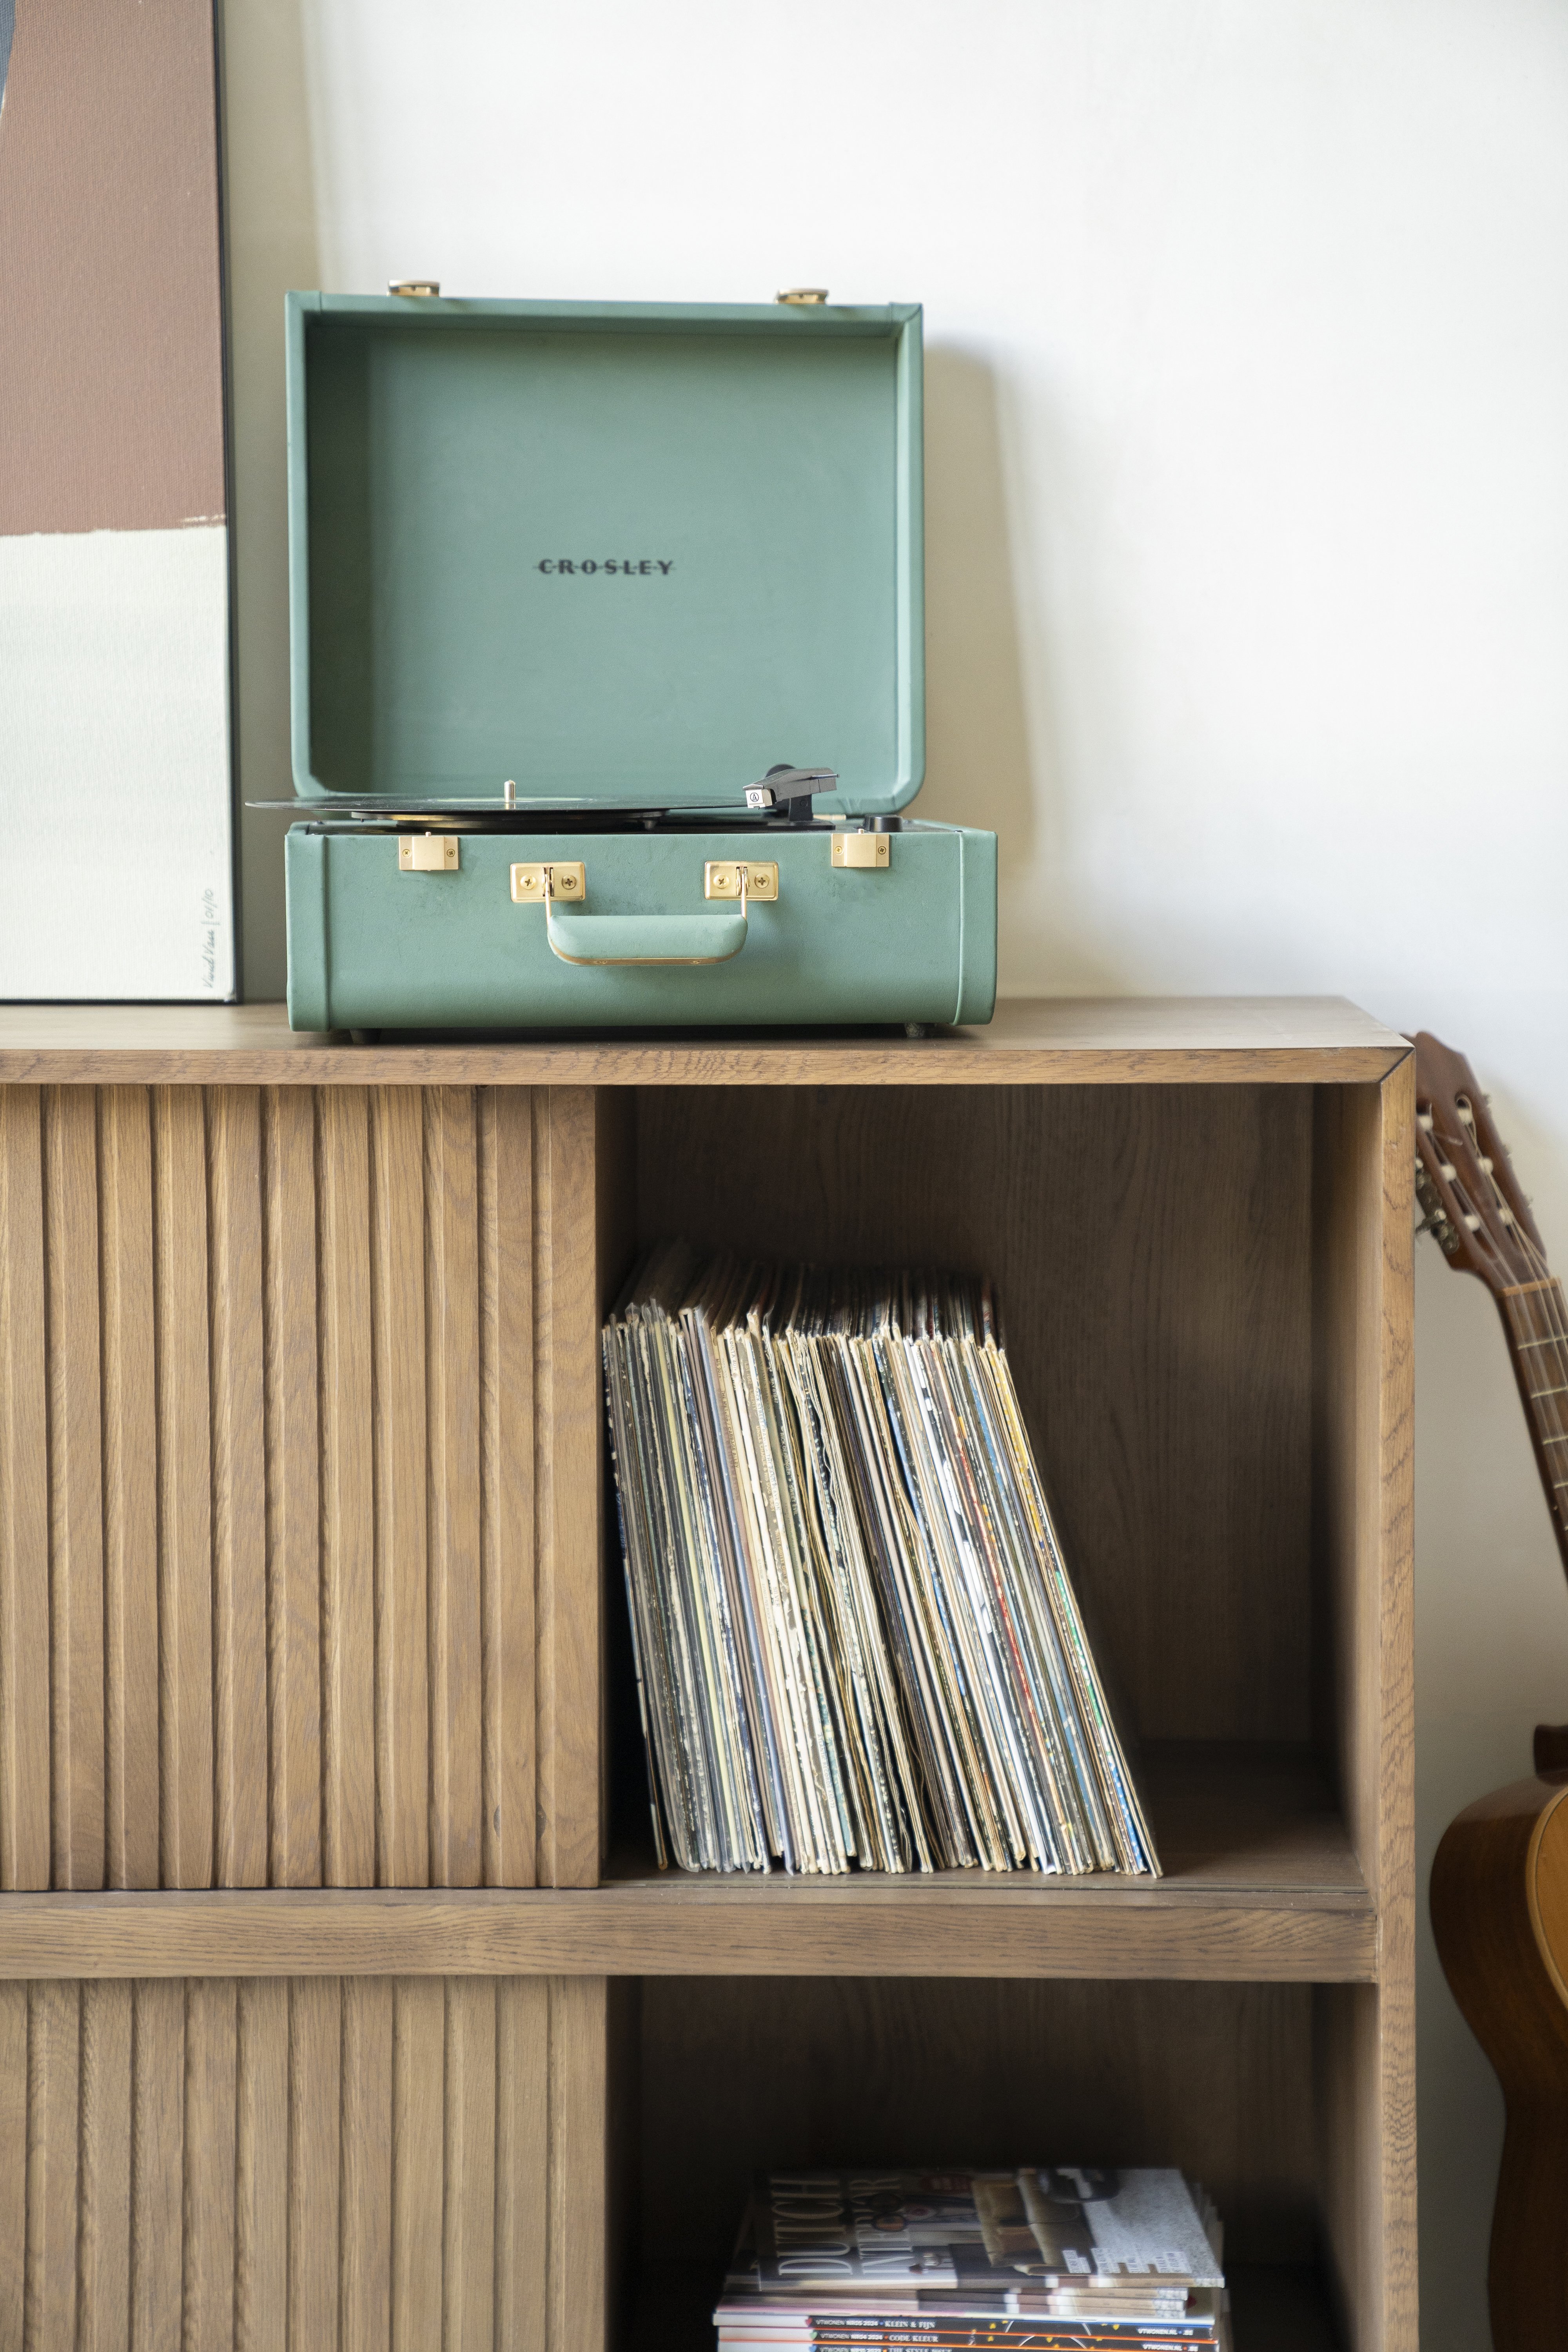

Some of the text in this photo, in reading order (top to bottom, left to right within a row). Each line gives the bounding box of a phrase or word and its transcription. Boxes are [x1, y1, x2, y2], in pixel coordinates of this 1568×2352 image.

[538, 559, 673, 575] CROSLEY
[782, 1445, 791, 1475] DERRINGER
[817, 1734, 826, 1760] ATLANTIC
[771, 2178, 853, 2276] DUTCH
[918, 2321, 935, 2330] FIJN
